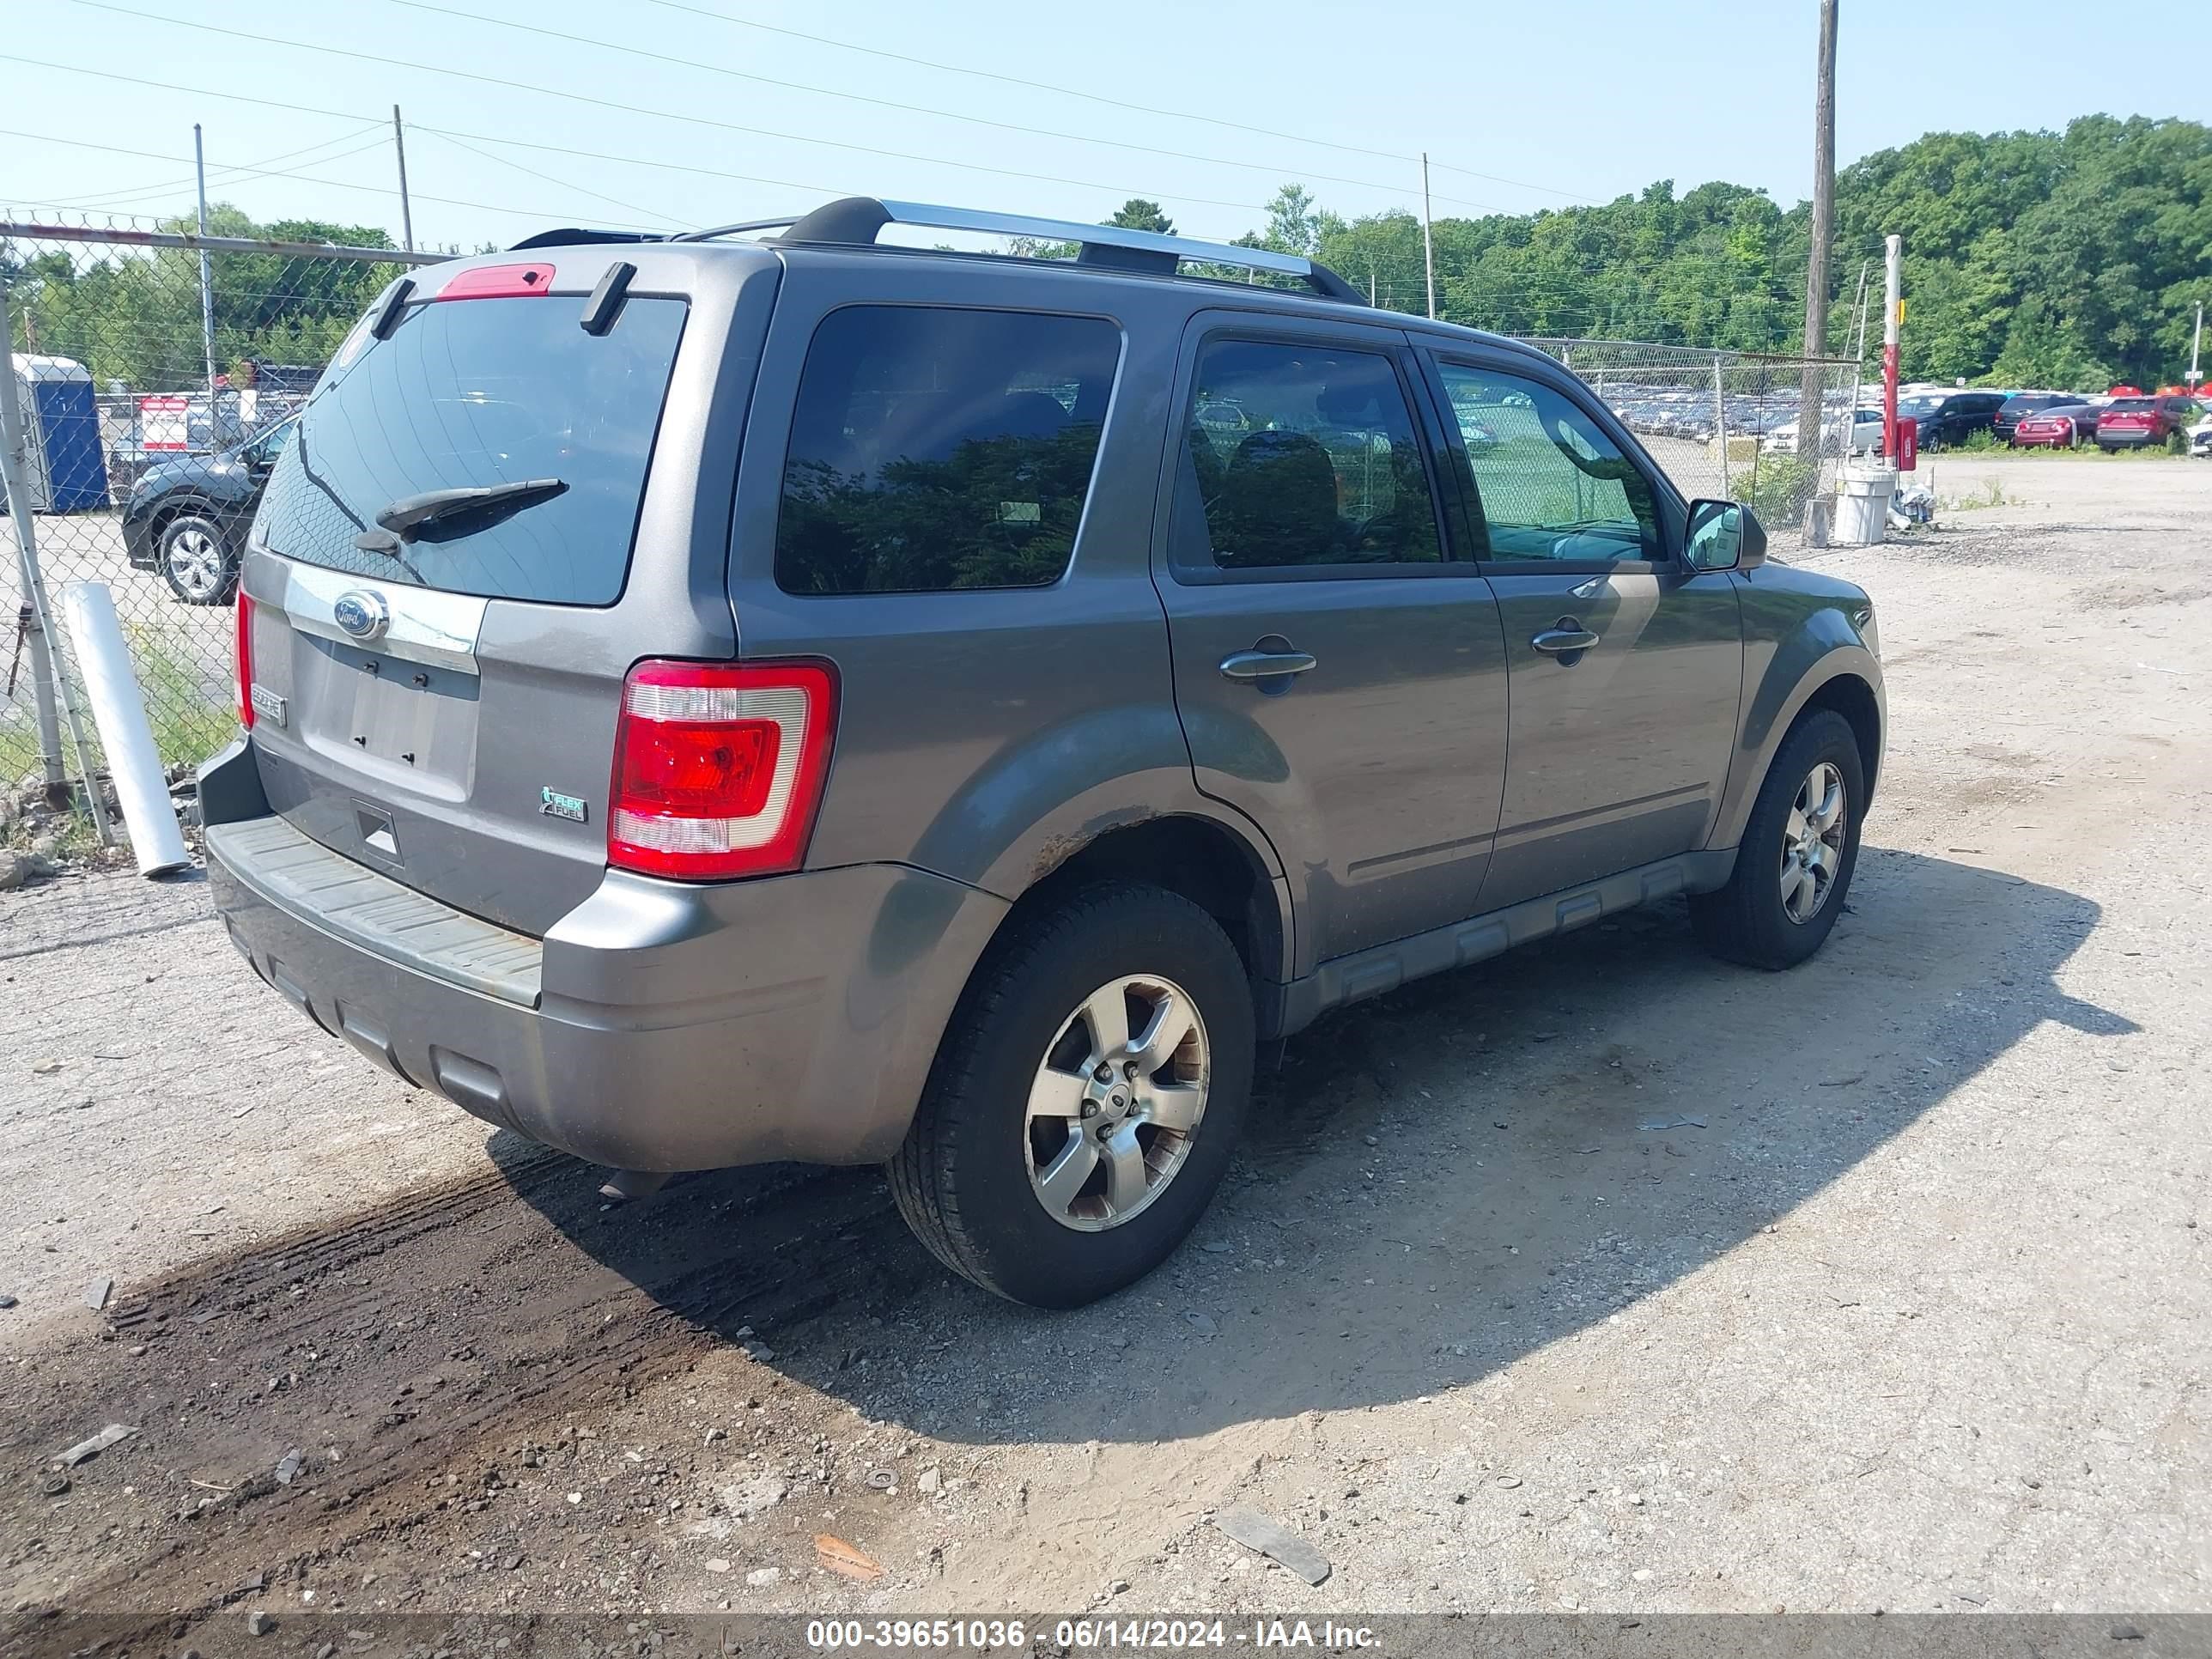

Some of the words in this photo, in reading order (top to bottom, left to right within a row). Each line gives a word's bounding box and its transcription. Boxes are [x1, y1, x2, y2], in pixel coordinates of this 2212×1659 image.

[337, 601, 361, 626] Ford
[554, 795, 582, 811] FLEX
[556, 805, 582, 820] FUEL
